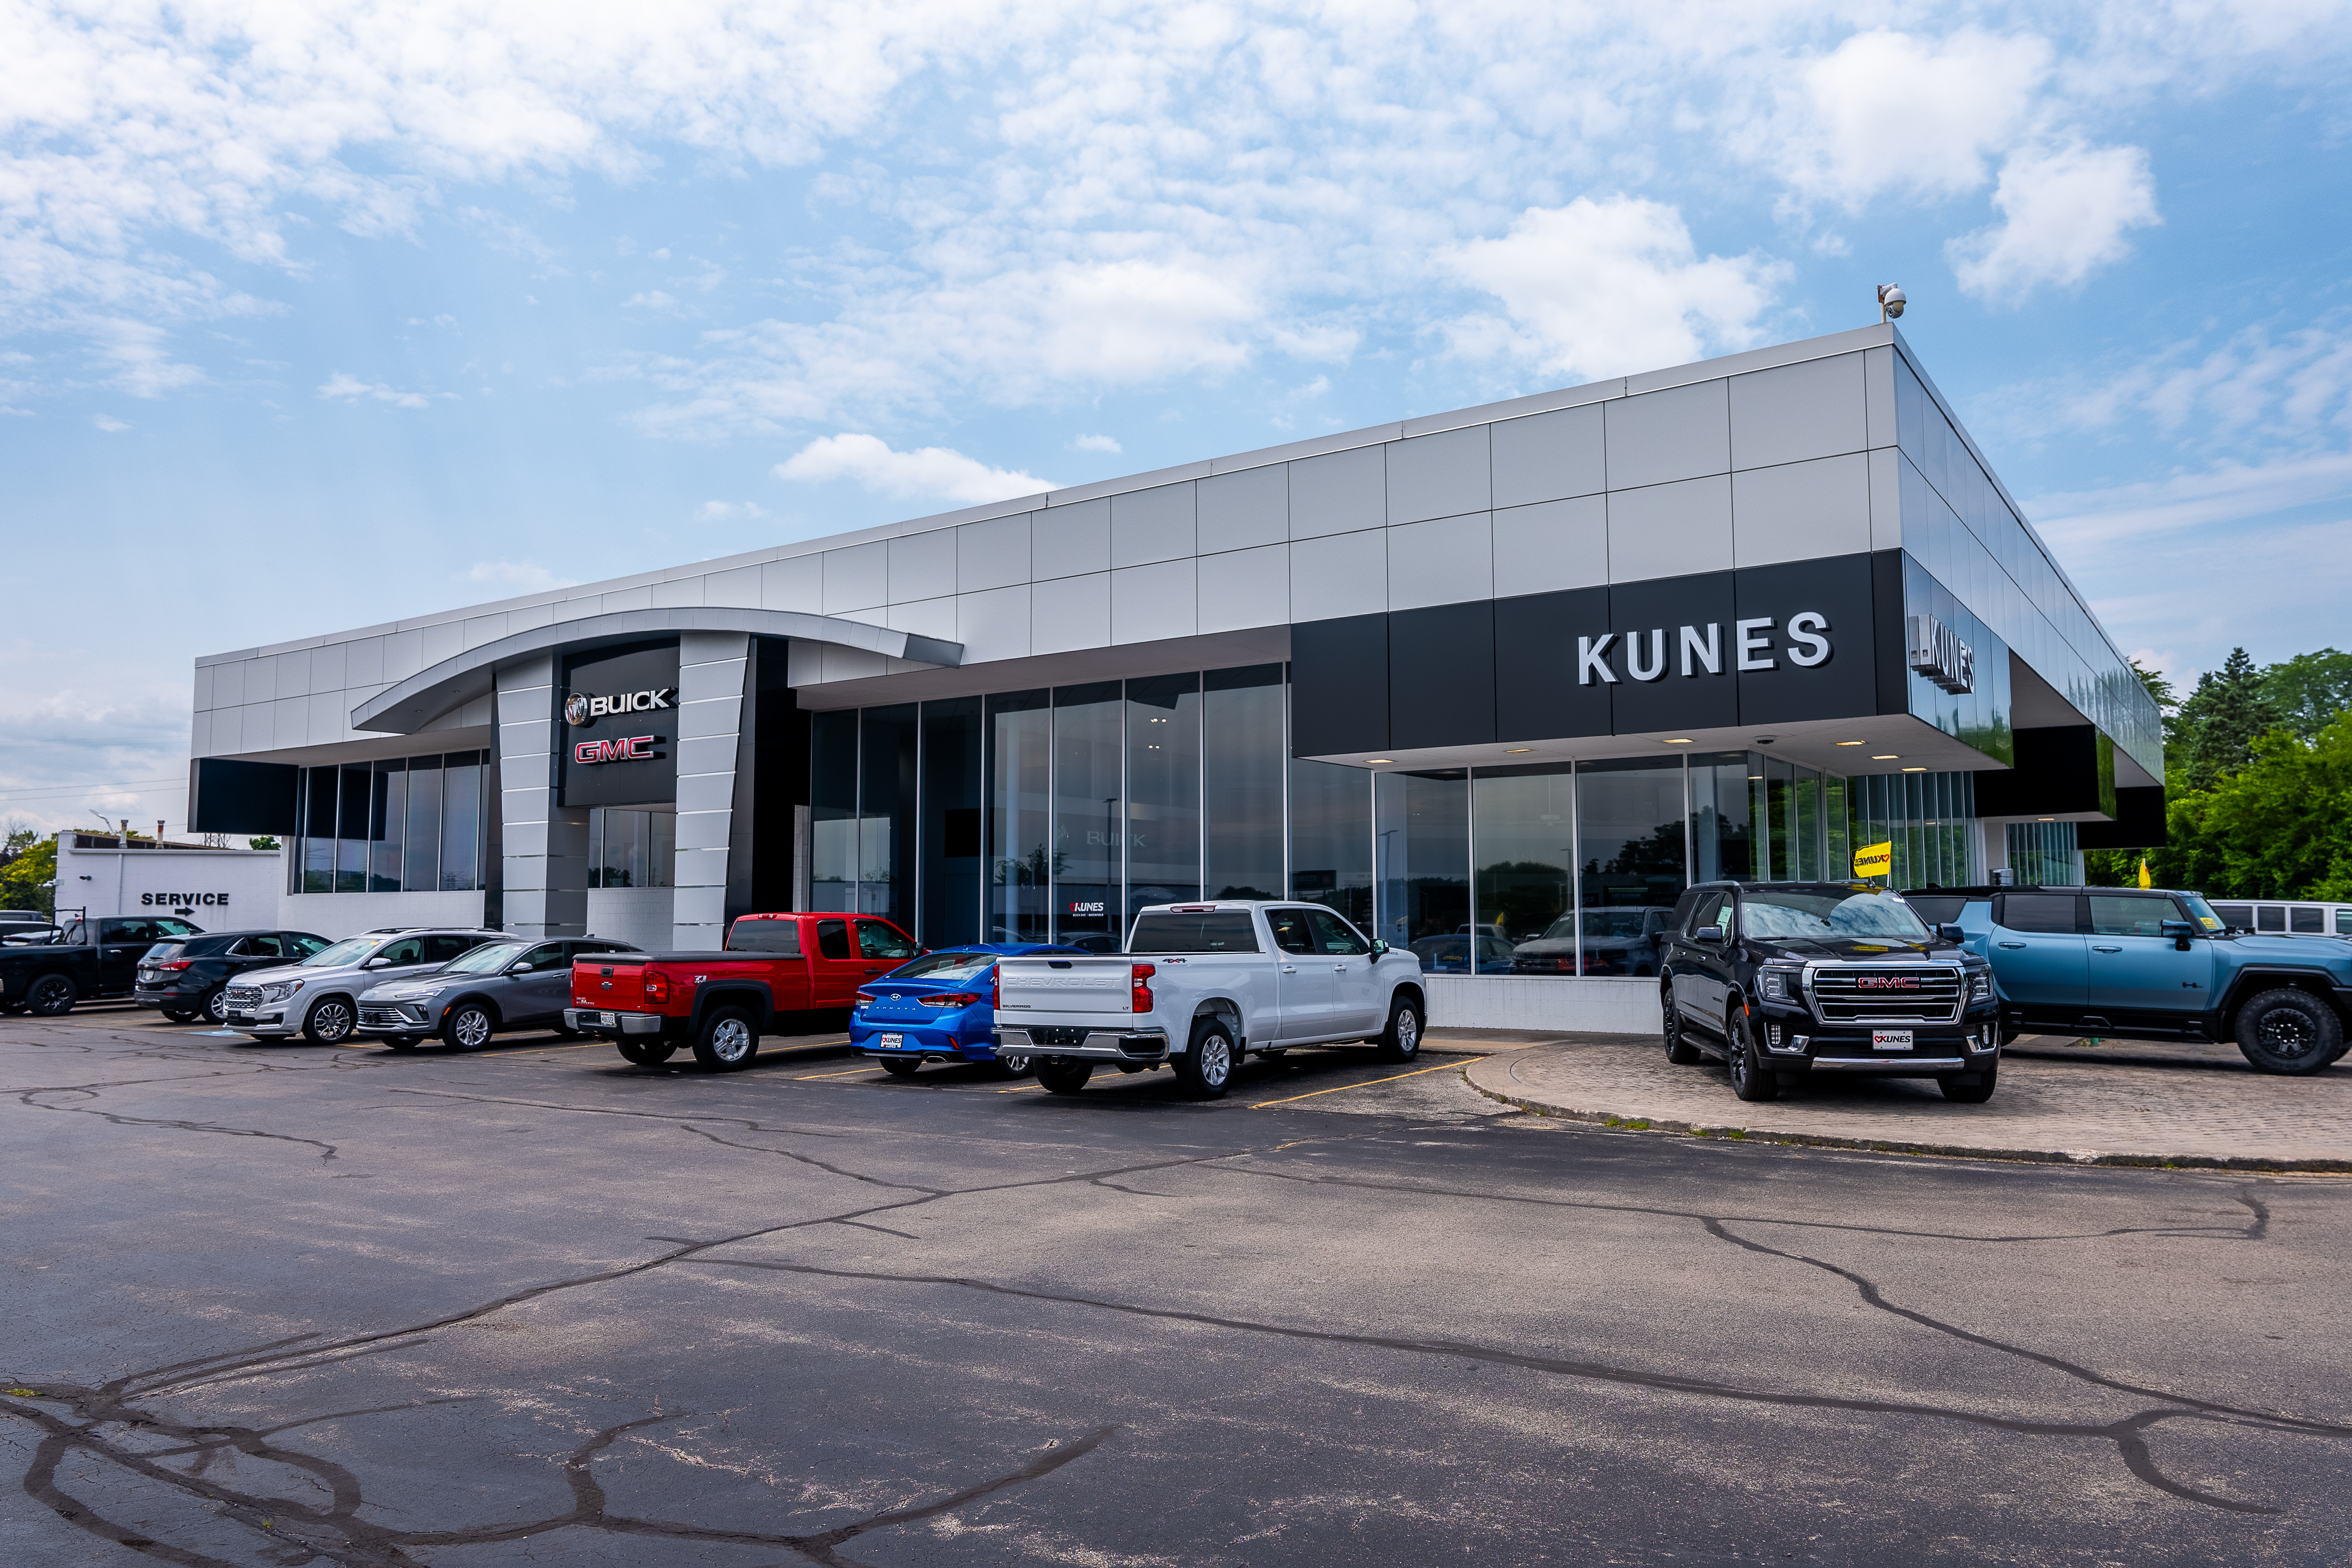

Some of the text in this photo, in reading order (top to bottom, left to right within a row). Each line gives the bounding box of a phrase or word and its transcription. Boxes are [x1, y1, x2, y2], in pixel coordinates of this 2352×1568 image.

[1578, 612, 1831, 685] KUNES
[1930, 614, 1974, 694] KUNES
[590, 688, 669, 716] BUICK
[575, 735, 654, 764] GMC
[1087, 830, 1147, 848] BUIK
[141, 893, 229, 906] SERVICE
[1074, 902, 1104, 911] KUNES
[1006, 978, 1120, 987] CHEVROLET
[1858, 977, 1920, 988] GMC
